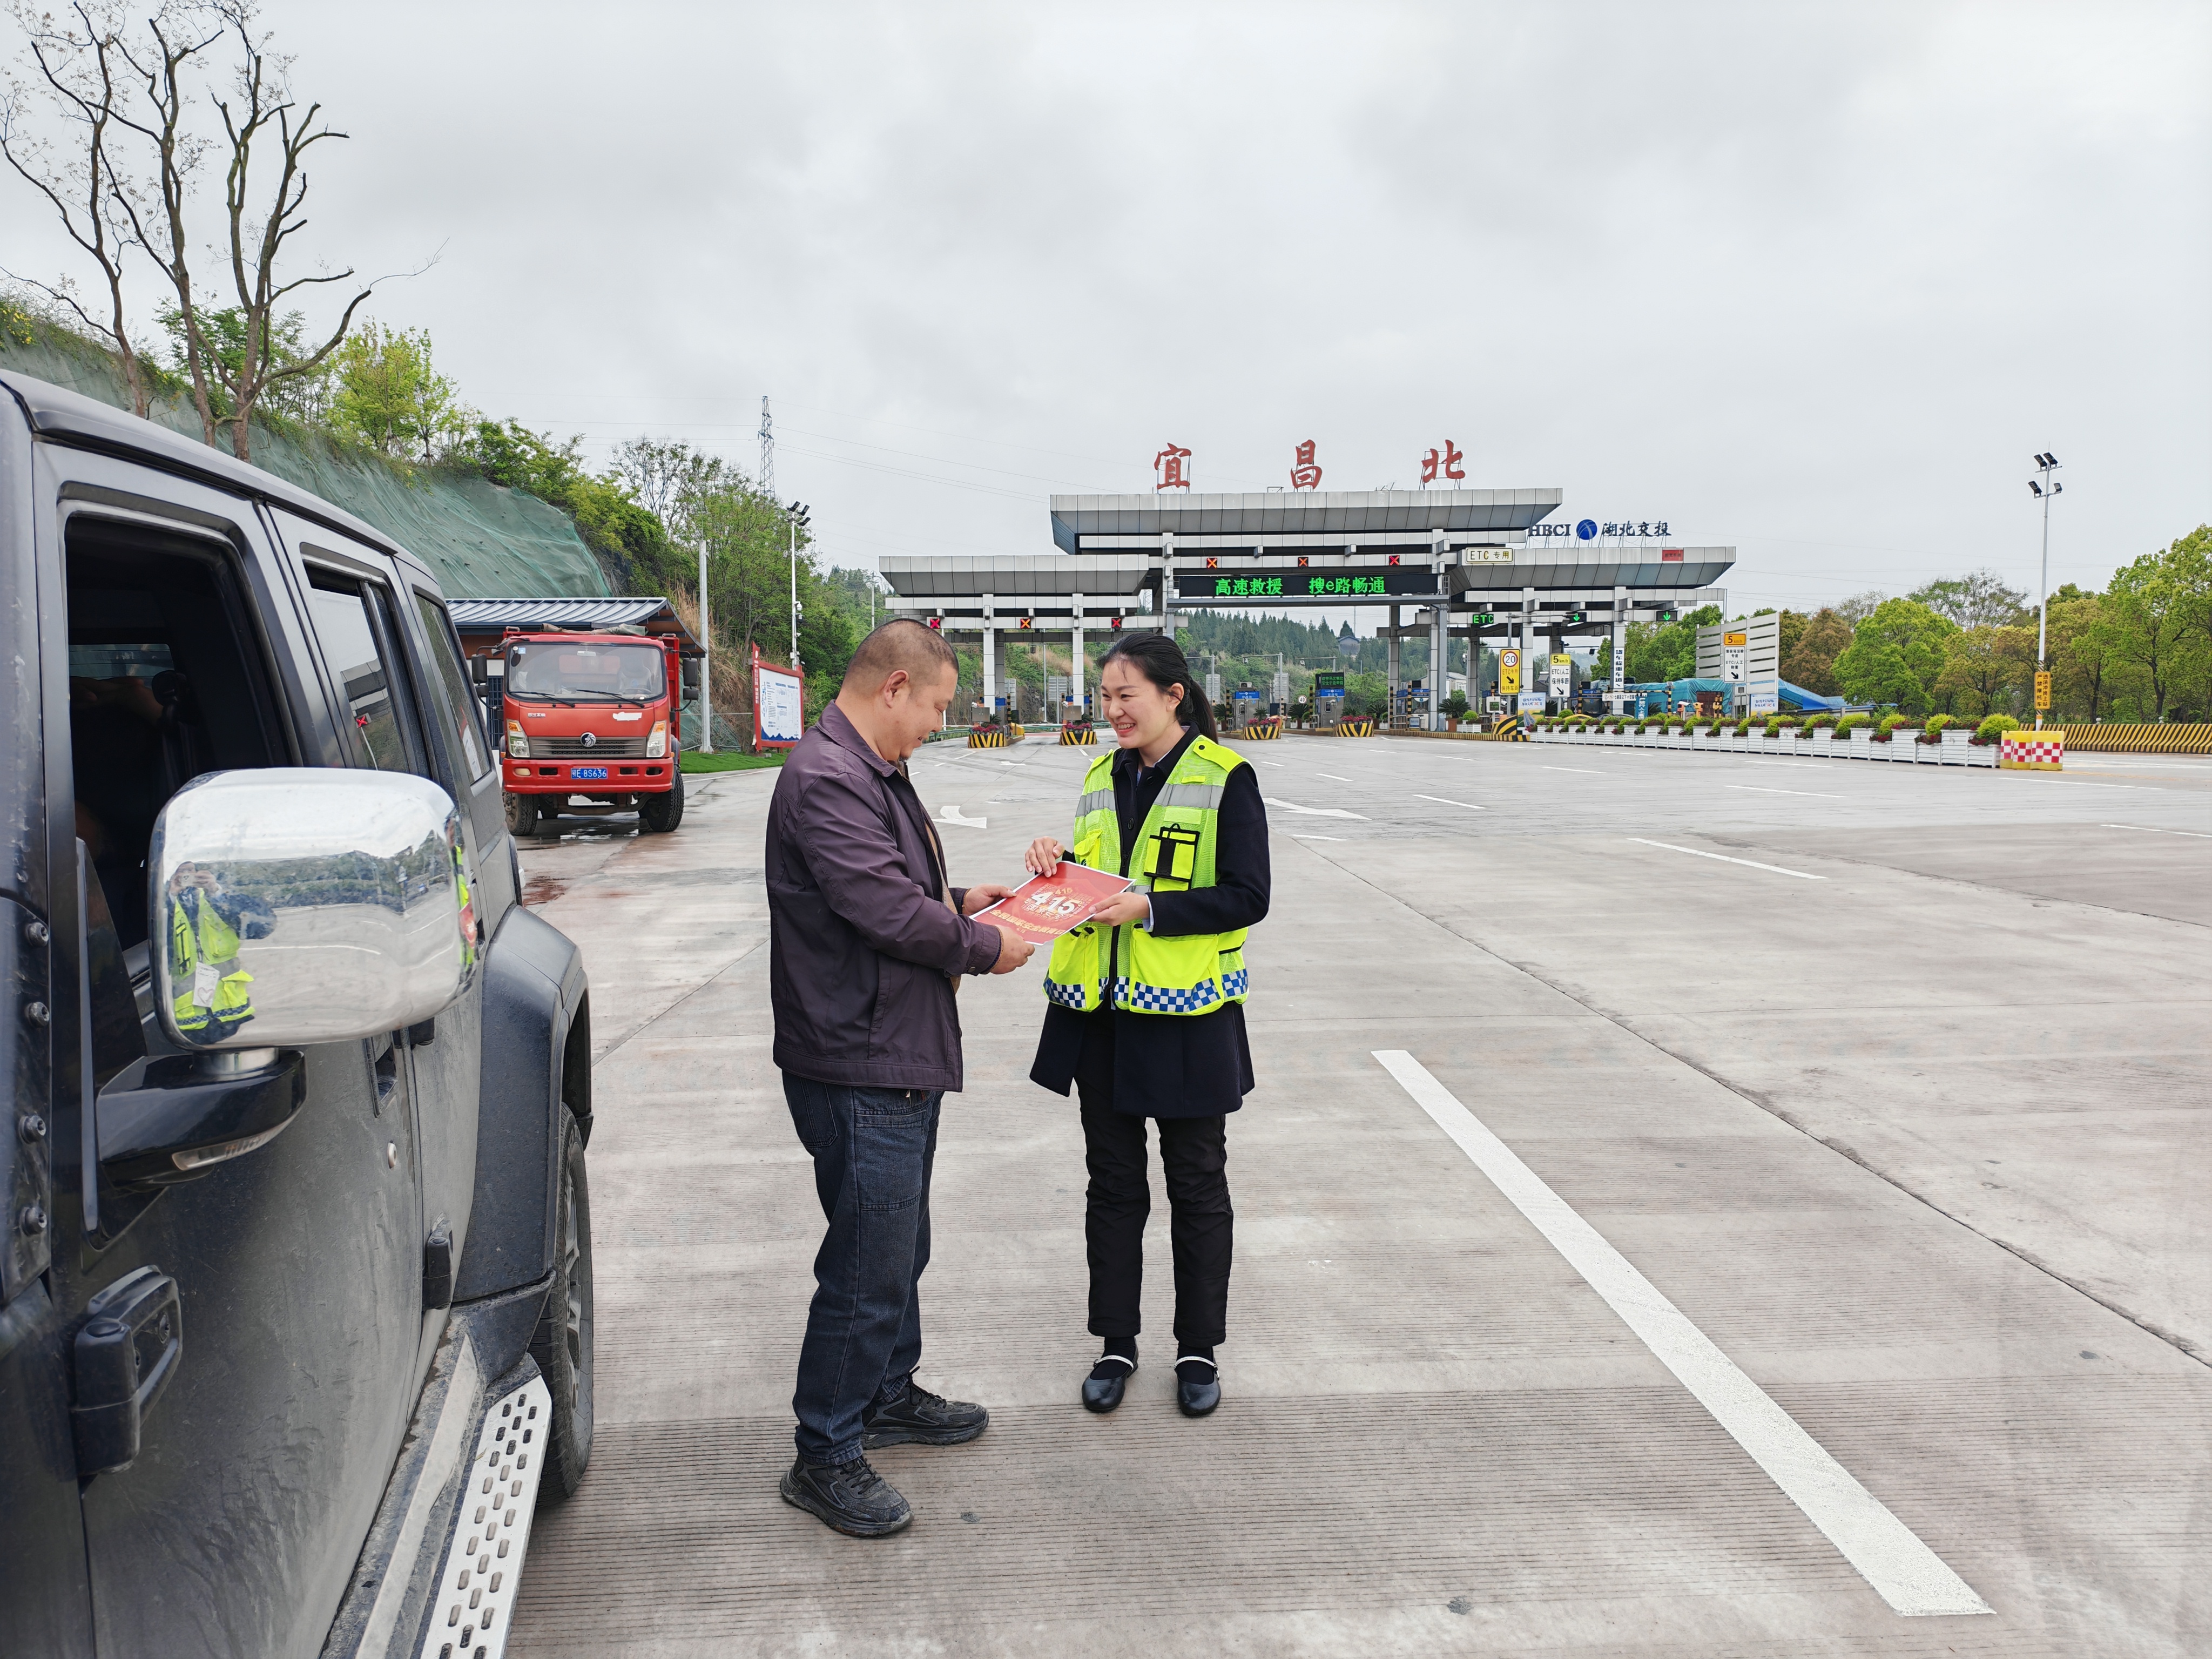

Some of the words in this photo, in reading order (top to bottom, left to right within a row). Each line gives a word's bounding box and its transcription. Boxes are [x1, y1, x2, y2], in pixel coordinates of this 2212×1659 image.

[1154, 439, 1466, 490] 宜昌北
[1528, 524, 1571, 536] HBCI
[1602, 520, 1672, 537] 湖北交投
[1470, 550, 1489, 560] ETC
[1493, 551, 1509, 559] 专用
[1215, 577, 1284, 596] 高速救援
[1308, 576, 1386, 594] 搜e路畅通
[1473, 615, 1494, 624] ETC
[1505, 655, 1516, 663] 20
[1026, 903, 1064, 921] 国家安全
[1031, 892, 1081, 914] 415
[989, 909, 1067, 935] 全民国家安全教育日
